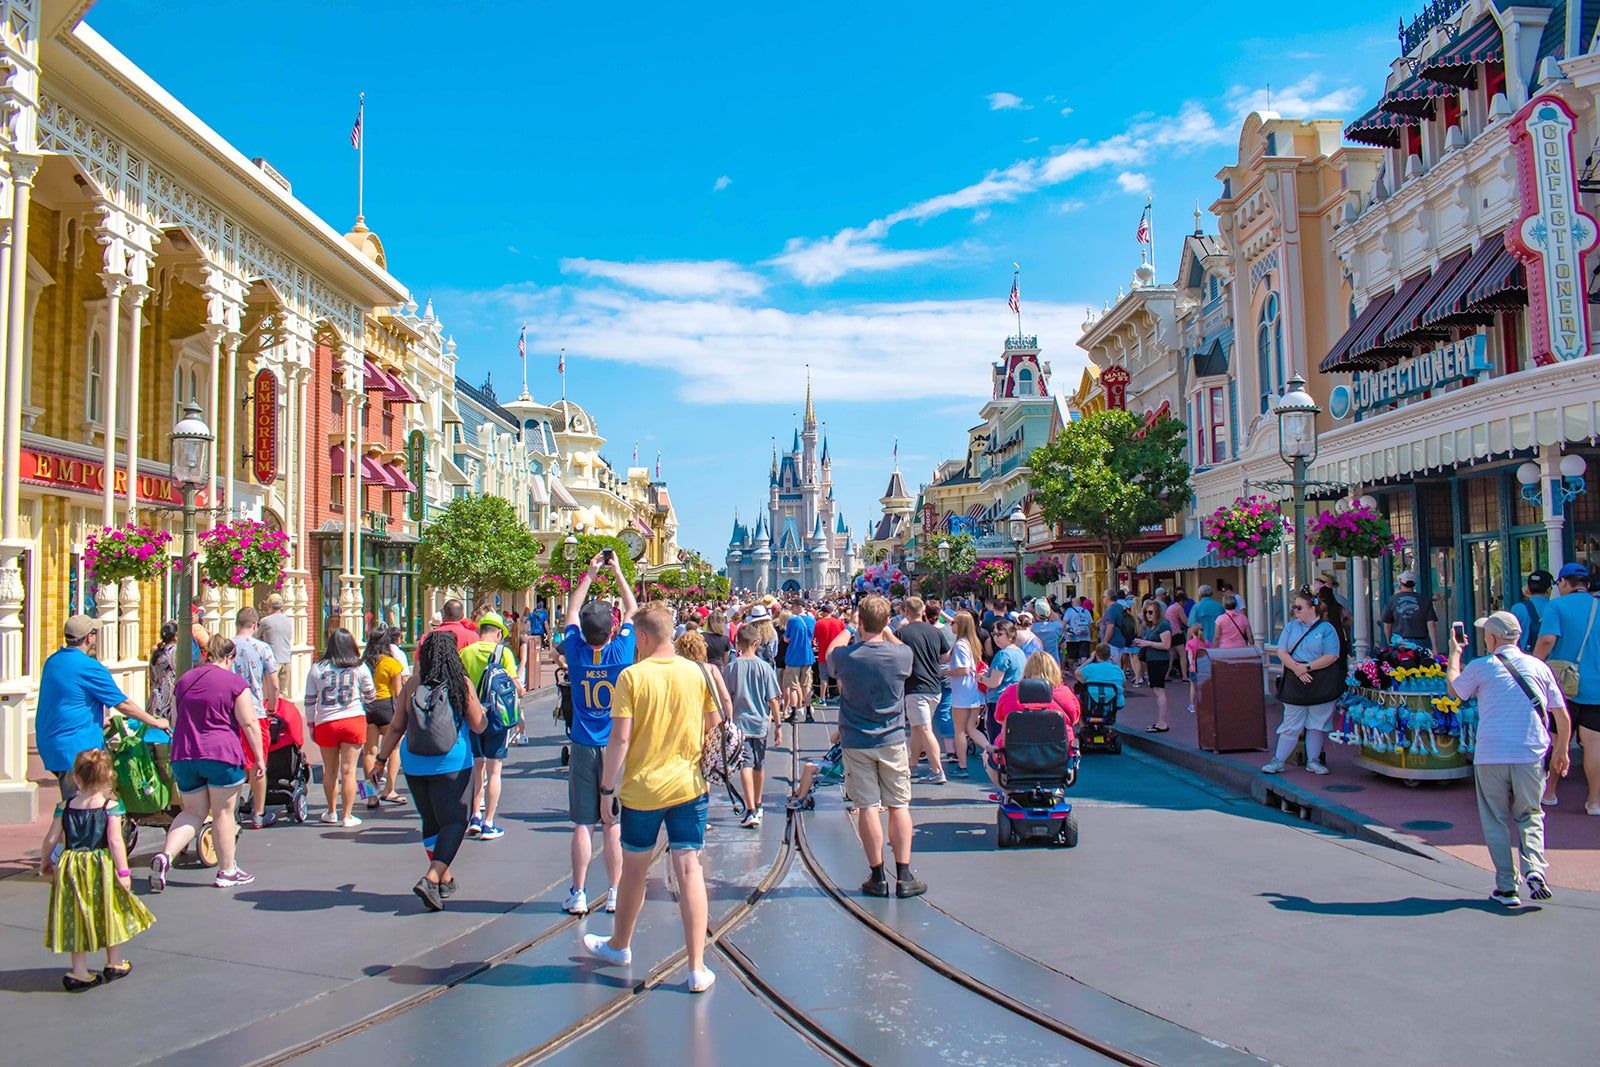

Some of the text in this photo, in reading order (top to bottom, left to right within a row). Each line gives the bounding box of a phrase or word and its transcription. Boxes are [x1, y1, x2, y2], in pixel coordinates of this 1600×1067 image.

[1543, 124, 1577, 350] CONFECTIONERY
[1351, 335, 1476, 411] CONFECTIONERY
[258, 381, 272, 472] EMPORIUM
[34, 453, 173, 501] EMPRUM
[321, 669, 355, 706] 28
[581, 680, 615, 709] 10
[586, 670, 608, 679] MESSI
